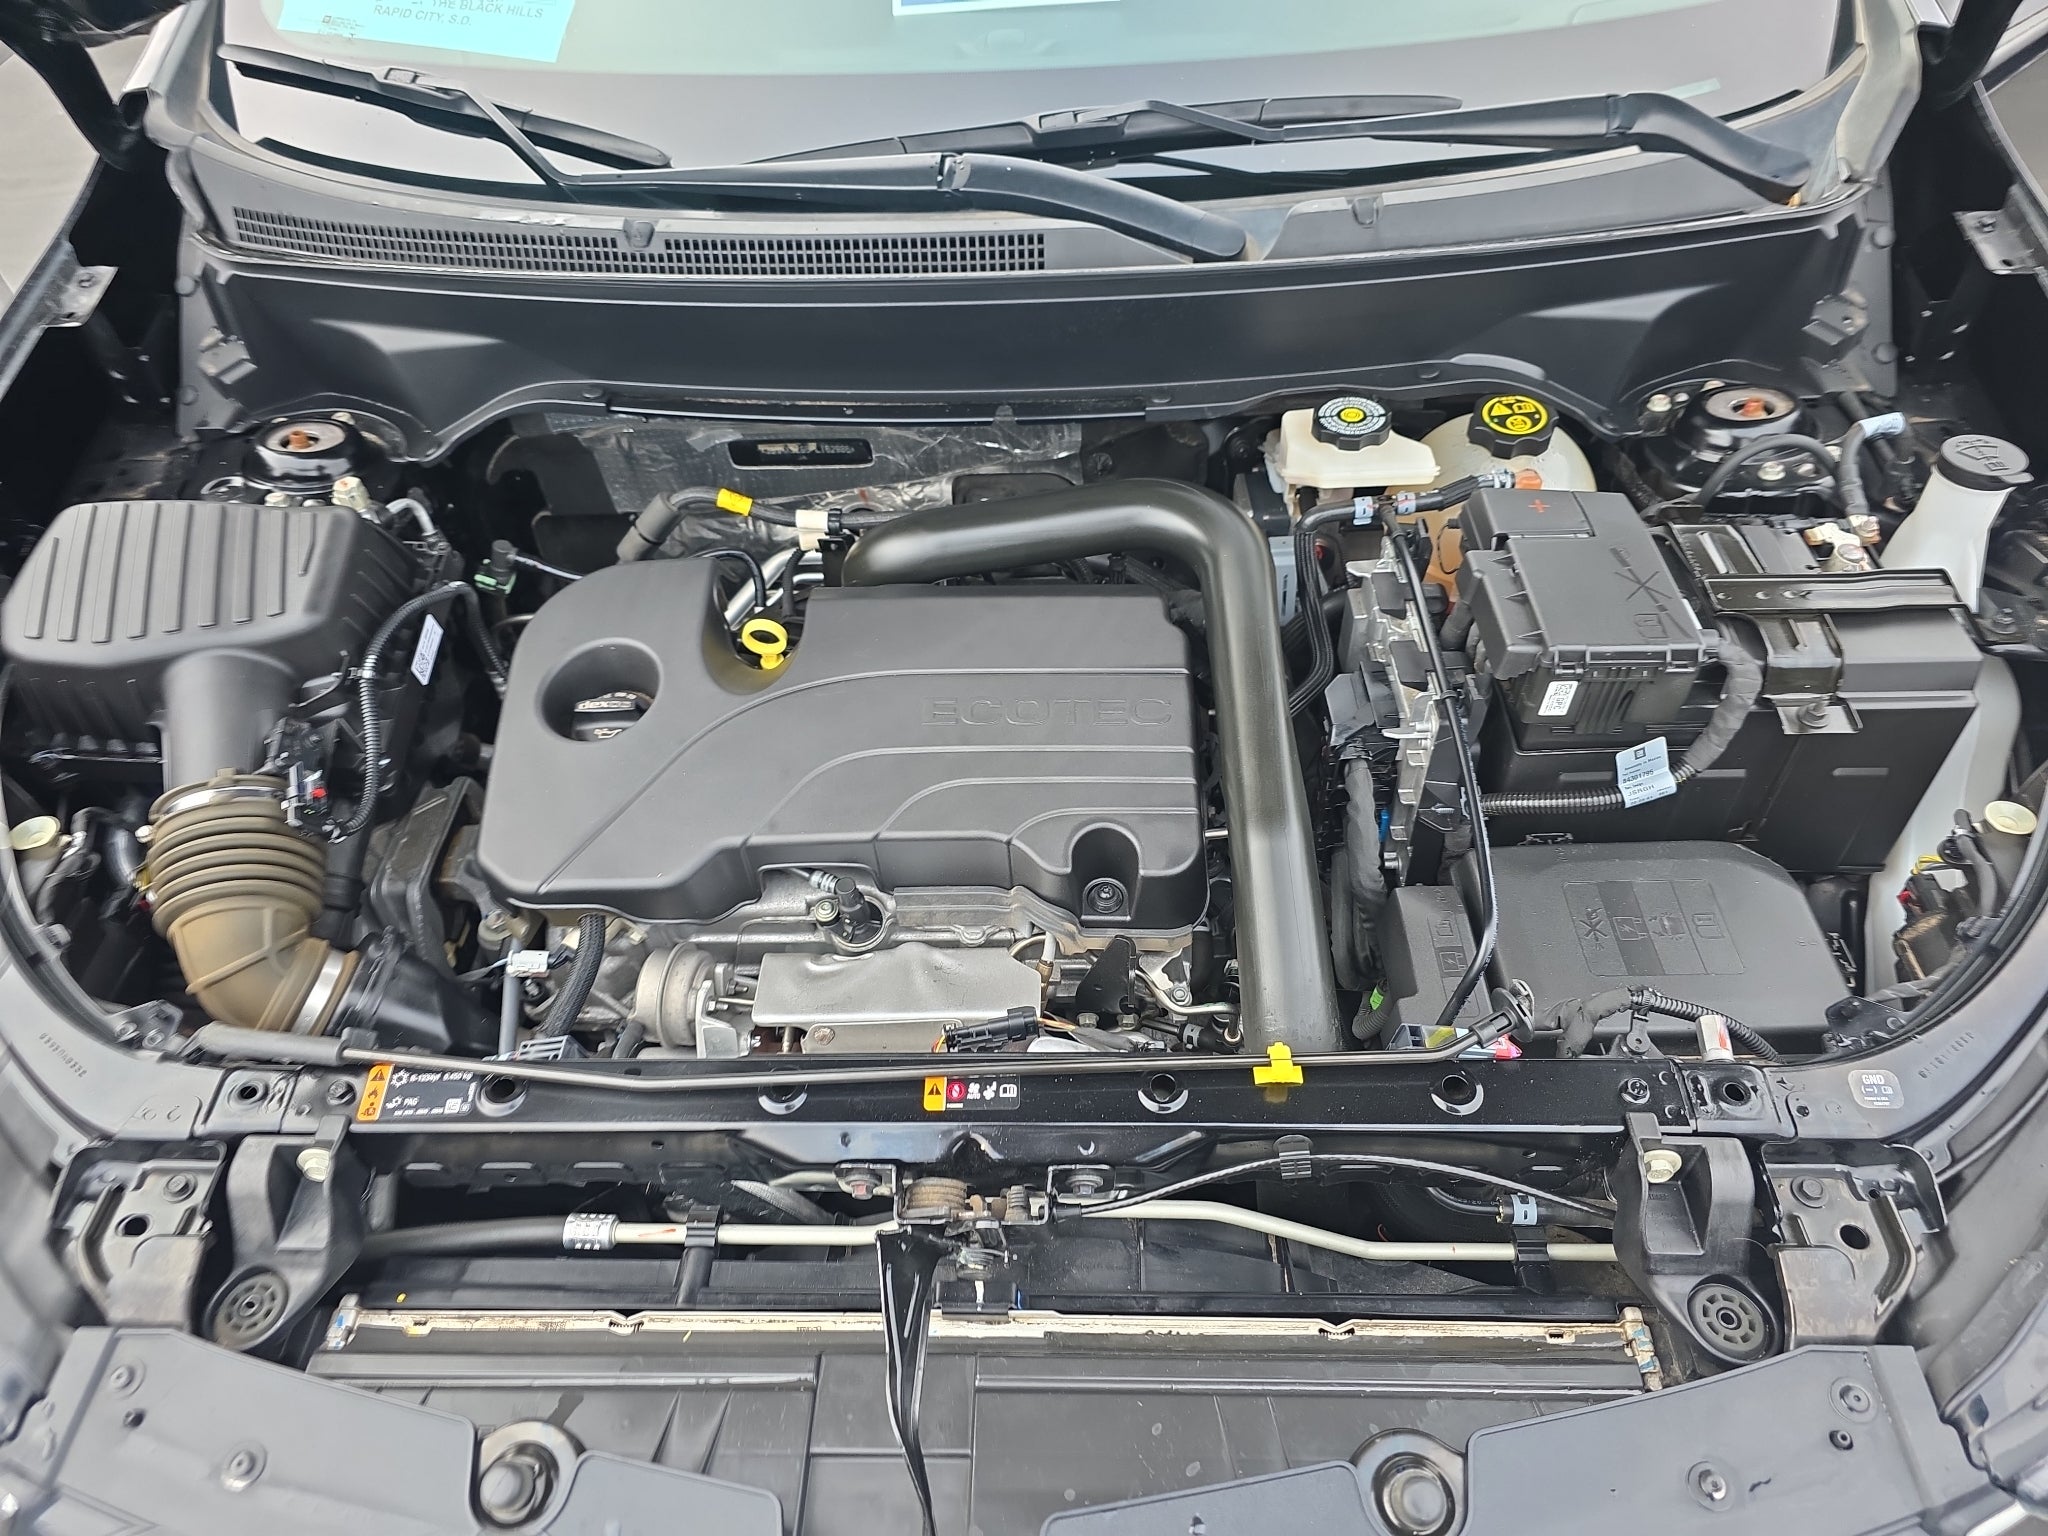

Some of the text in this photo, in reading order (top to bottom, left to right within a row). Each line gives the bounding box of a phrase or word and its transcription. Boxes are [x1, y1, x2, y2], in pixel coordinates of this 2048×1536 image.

[373, 4, 472, 26] RAPID CITY, S.D.
[459, 0, 503, 14] BLACK
[506, 5, 544, 18] HILLS
[920, 697, 1172, 726] ECOTEC
[1861, 1074, 1885, 1084] GND
[403, 1097, 419, 1106] PAG
